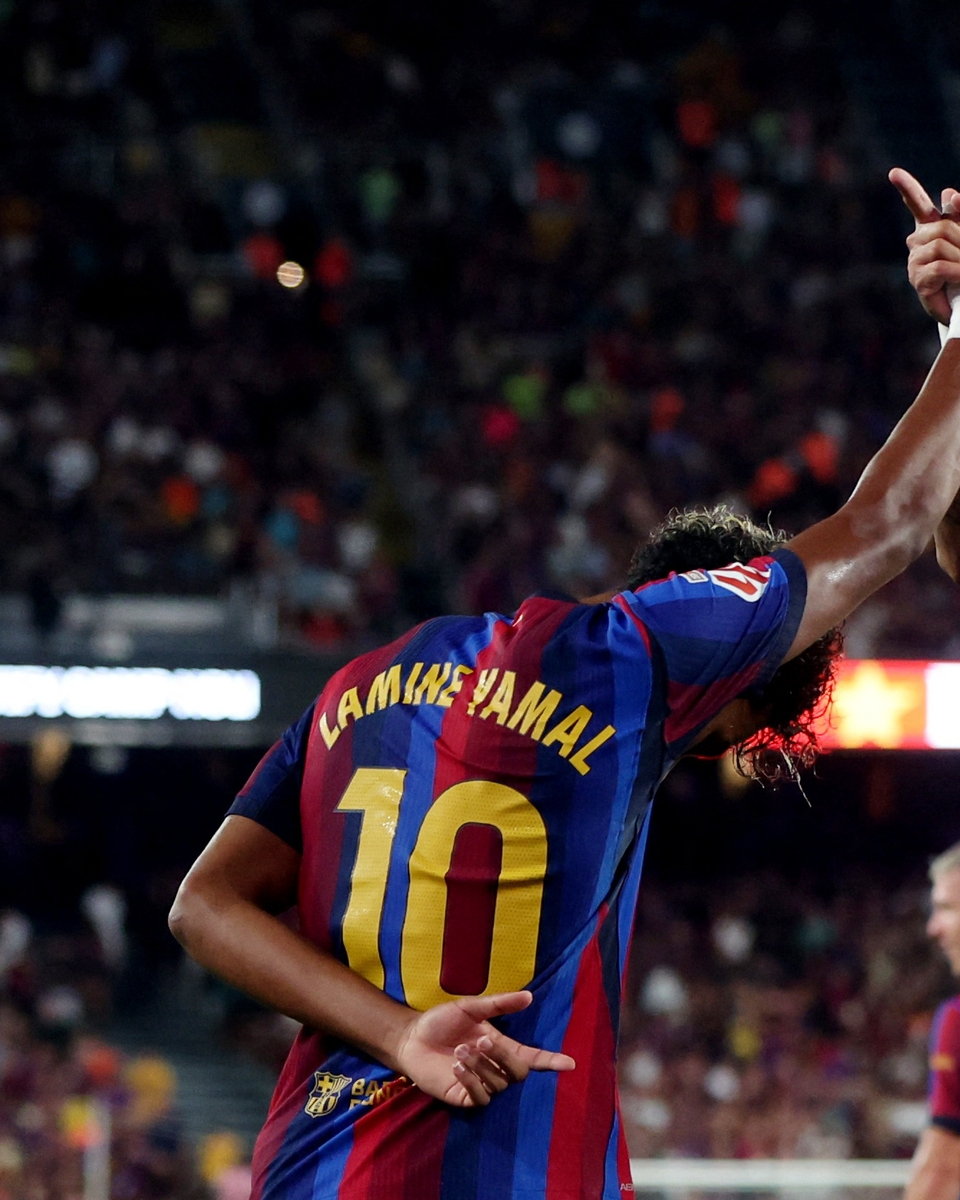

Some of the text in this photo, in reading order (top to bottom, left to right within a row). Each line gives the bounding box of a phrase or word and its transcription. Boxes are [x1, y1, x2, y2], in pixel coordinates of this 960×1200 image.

[318, 662, 473, 751] LAMINE
[467, 667, 616, 776] YAMAL
[334, 767, 548, 1012] 10
